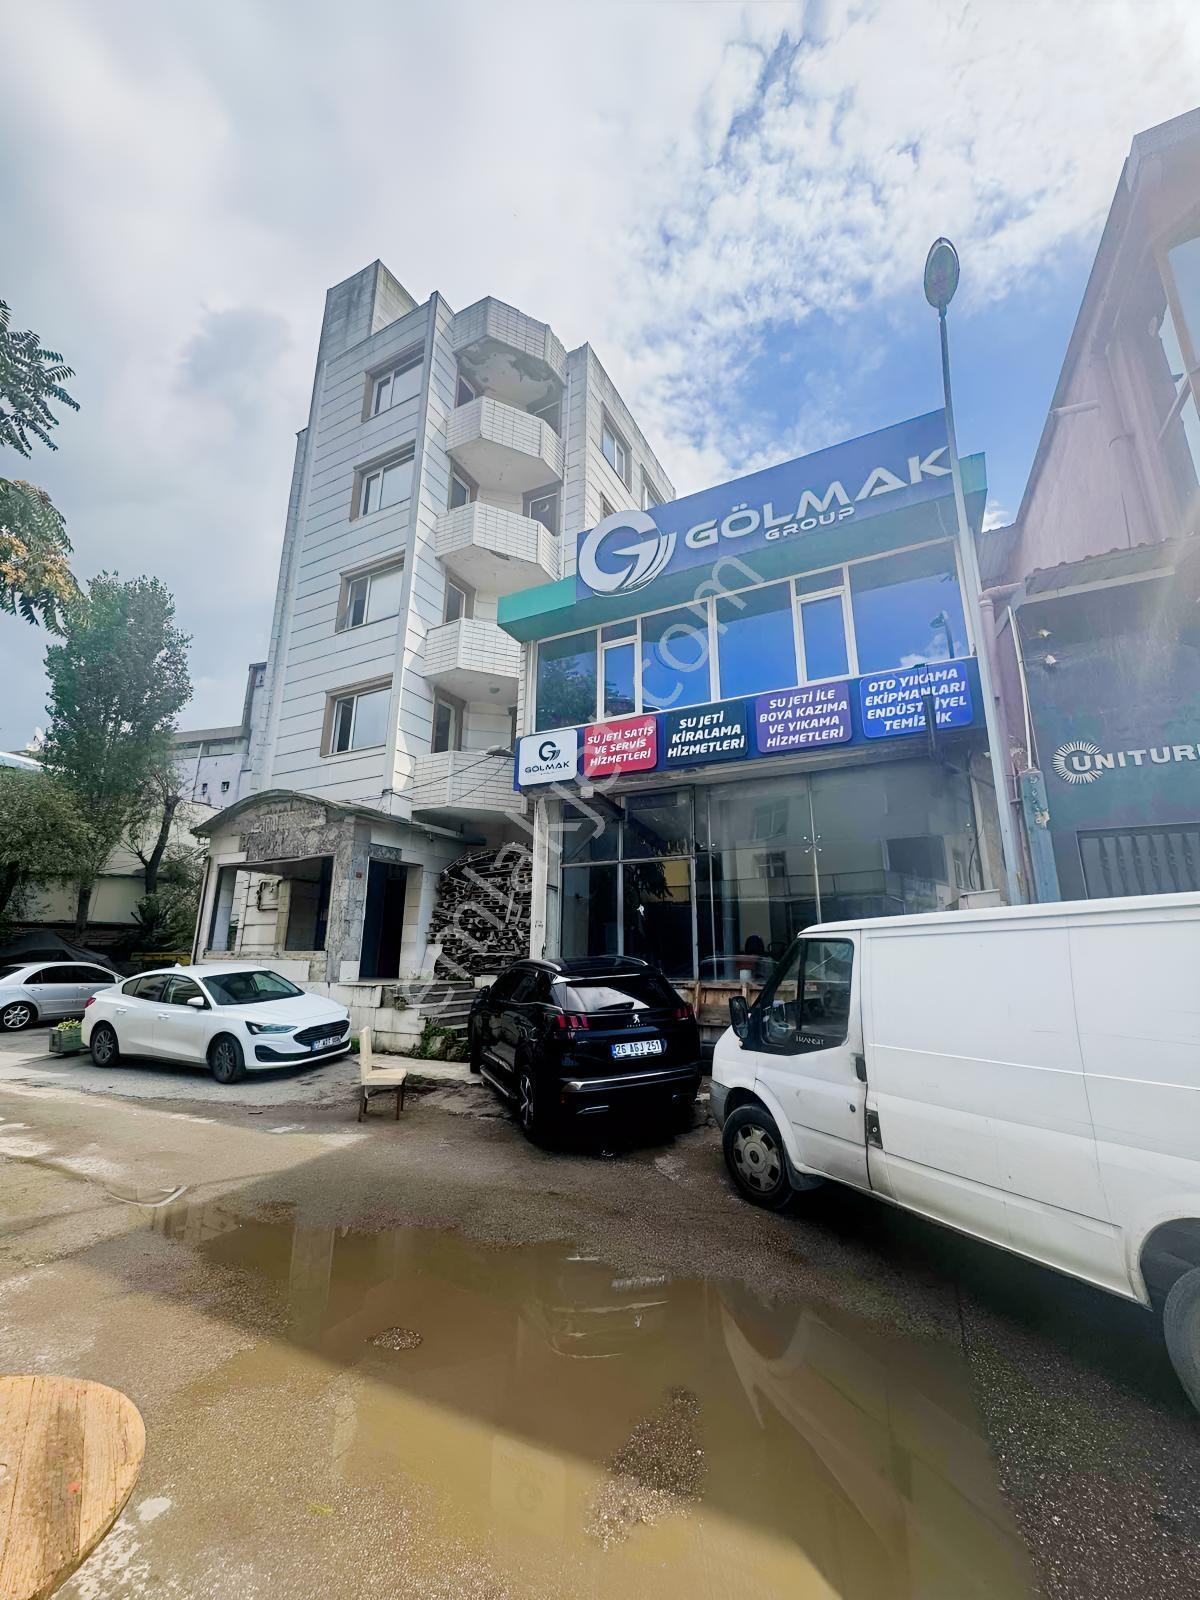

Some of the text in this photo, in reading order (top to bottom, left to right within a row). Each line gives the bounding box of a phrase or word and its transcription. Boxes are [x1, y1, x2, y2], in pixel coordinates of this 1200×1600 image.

[684, 445, 953, 549] GÖLMAK
[764, 507, 856, 541] GROUP
[868, 668, 958, 692] OTO YIKAMA
[770, 689, 836, 709] SU JETİ İLE
[865, 681, 966, 706] EKİPMANLARI
[760, 701, 848, 722] BOYA KAZIMA
[867, 695, 967, 720] ENDÜSTİYEL
[679, 710, 724, 729] SU JETİ
[769, 715, 840, 734] VE YIKAMA
[883, 711, 952, 730] TEMİZİK
[587, 726, 654, 745] SU JETİ SATIŞ
[671, 724, 741, 744] KİRALAMA
[766, 725, 844, 747] HİZMETLERİ
[595, 738, 647, 754] VE SERVİS
[667, 735, 745, 758] HİZMETLERİ
[590, 748, 652, 767] HİZMETLERİ
[1072, 743, 1200, 771] UNITUR
[616, 1044, 627, 1055] 26
[646, 1040, 660, 1051] 251
